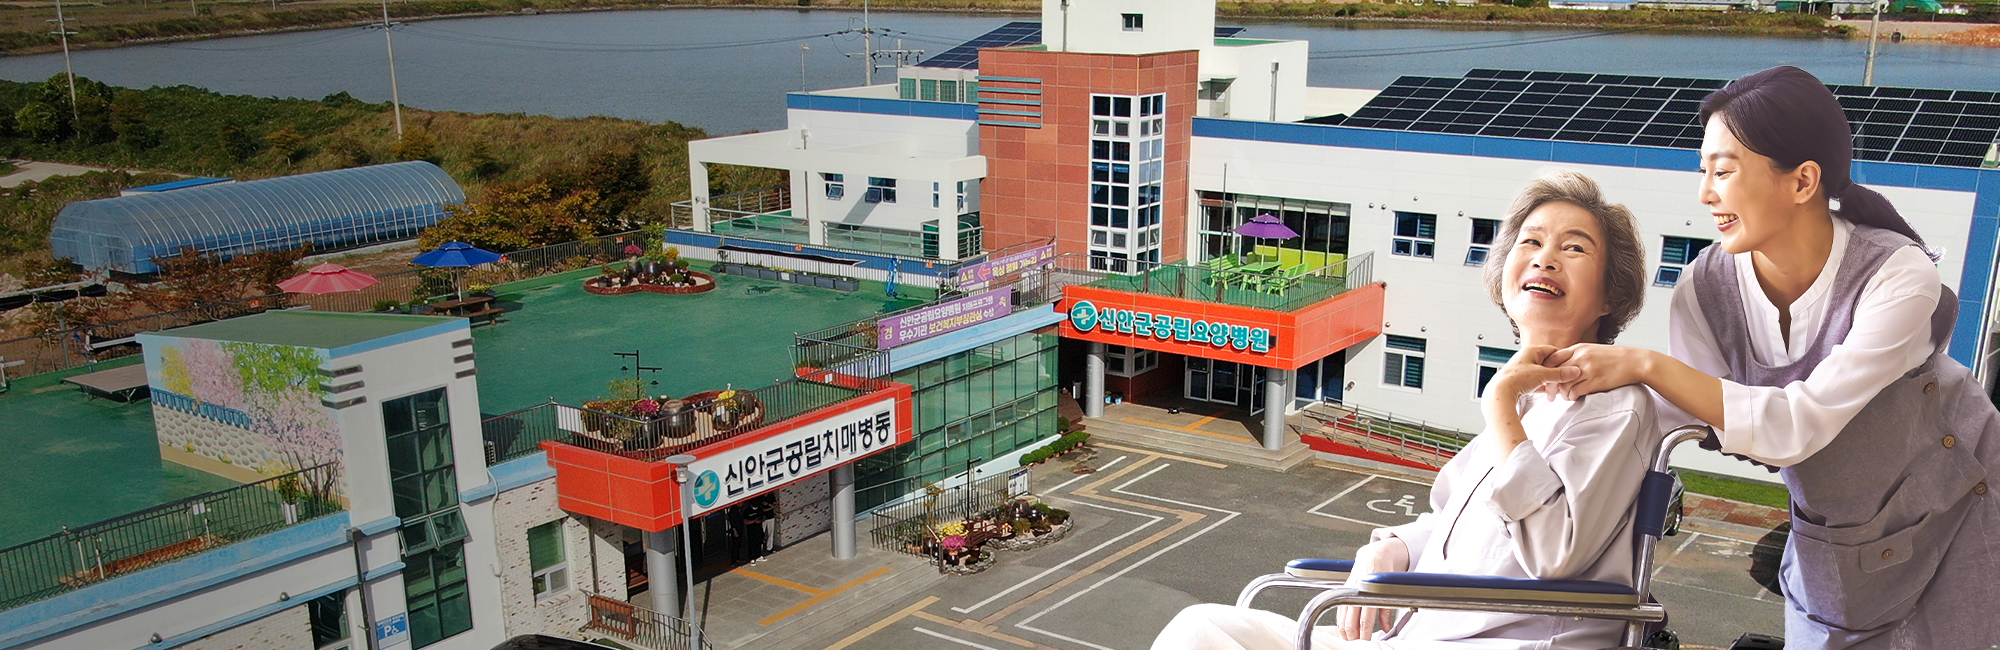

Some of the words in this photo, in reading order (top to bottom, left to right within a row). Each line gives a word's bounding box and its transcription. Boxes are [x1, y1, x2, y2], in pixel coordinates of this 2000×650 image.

[899, 325, 928, 342] 우수기관
[928, 309, 983, 334] 보건복지부장관상
[983, 307, 995, 319] 수상
[900, 301, 962, 329] 신안군공립요양병원
[1099, 307, 1270, 352] 신안군공립요양병원
[884, 326, 893, 340] 경
[724, 410, 891, 499] 신안군공립치매병동
[384, 625, 392, 637] P
